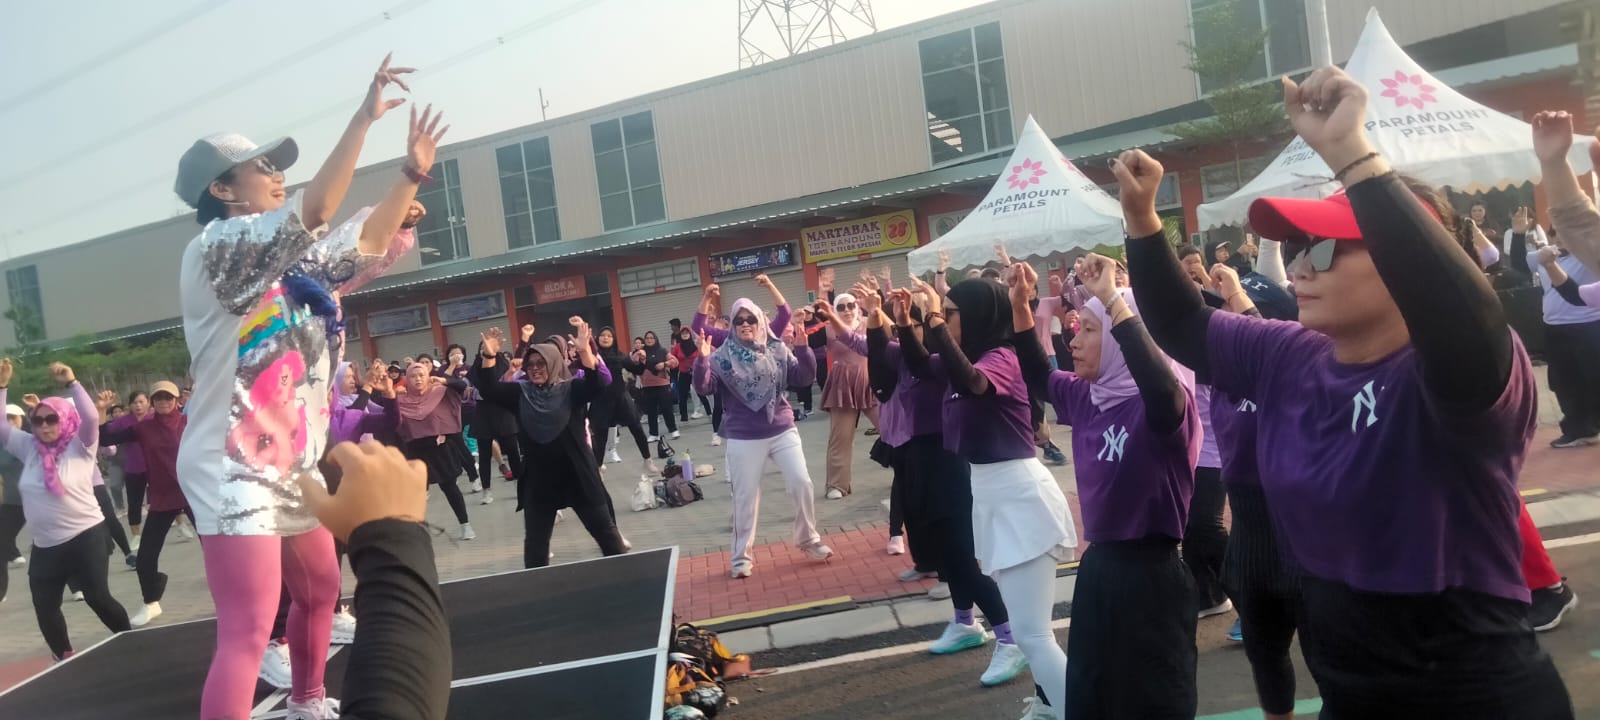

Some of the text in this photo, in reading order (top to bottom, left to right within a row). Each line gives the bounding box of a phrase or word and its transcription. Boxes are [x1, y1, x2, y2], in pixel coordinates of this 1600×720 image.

[1364, 108, 1488, 131] PARAMOUNT
[1402, 121, 1474, 137] PETALS
[979, 189, 1069, 213] PARAMOUNT
[993, 200, 1046, 215] PETALS
[806, 221, 880, 241] MARTABAK
[830, 232, 881, 246] BANDUNG
[888, 221, 907, 239] 28
[1098, 424, 1128, 462] NY
